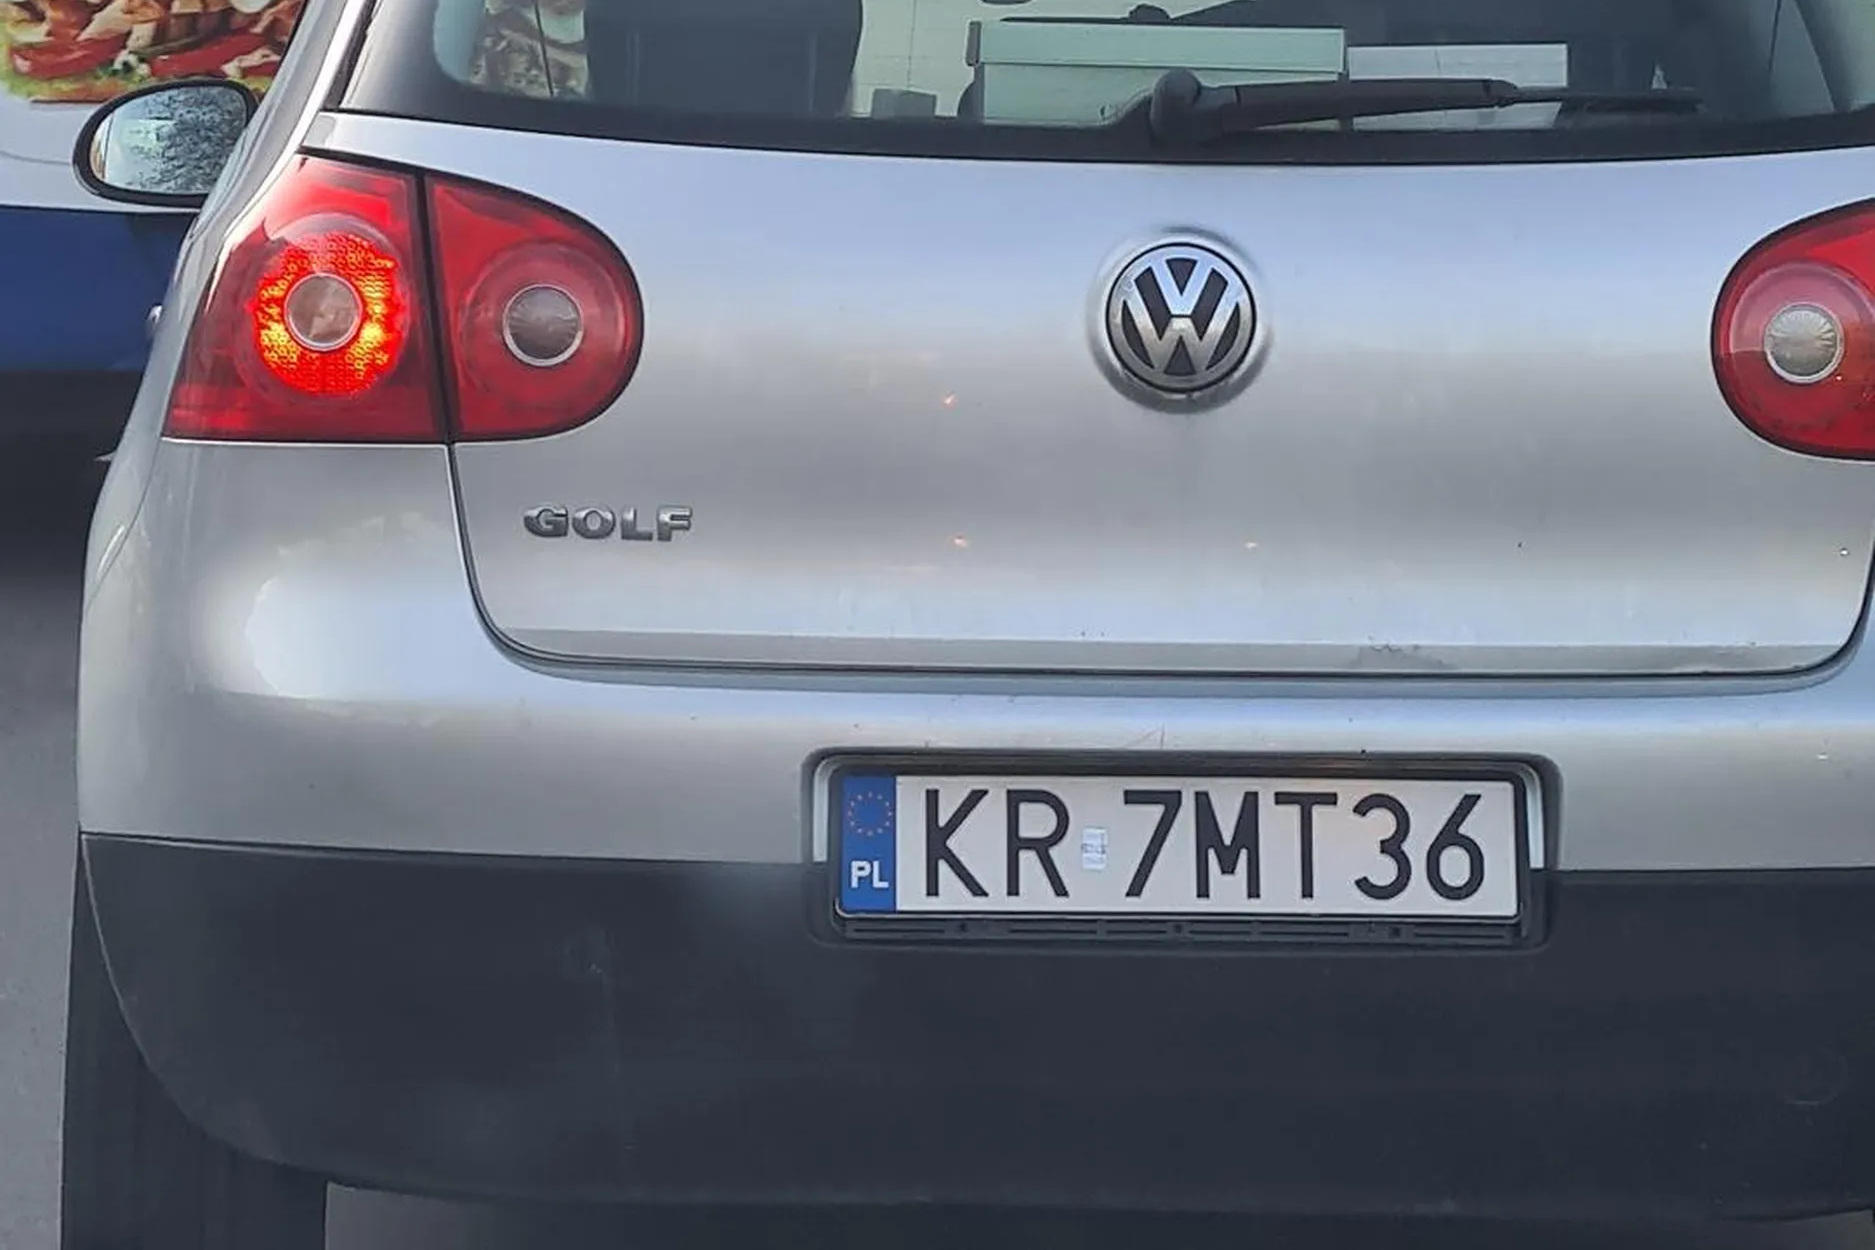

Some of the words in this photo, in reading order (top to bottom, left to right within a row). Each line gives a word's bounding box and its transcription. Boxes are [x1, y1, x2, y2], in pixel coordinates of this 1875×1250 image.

[523, 504, 692, 542] GOLF
[851, 861, 889, 889] PL
[924, 788, 1071, 897] KR
[1123, 789, 1486, 901] 7MT36
